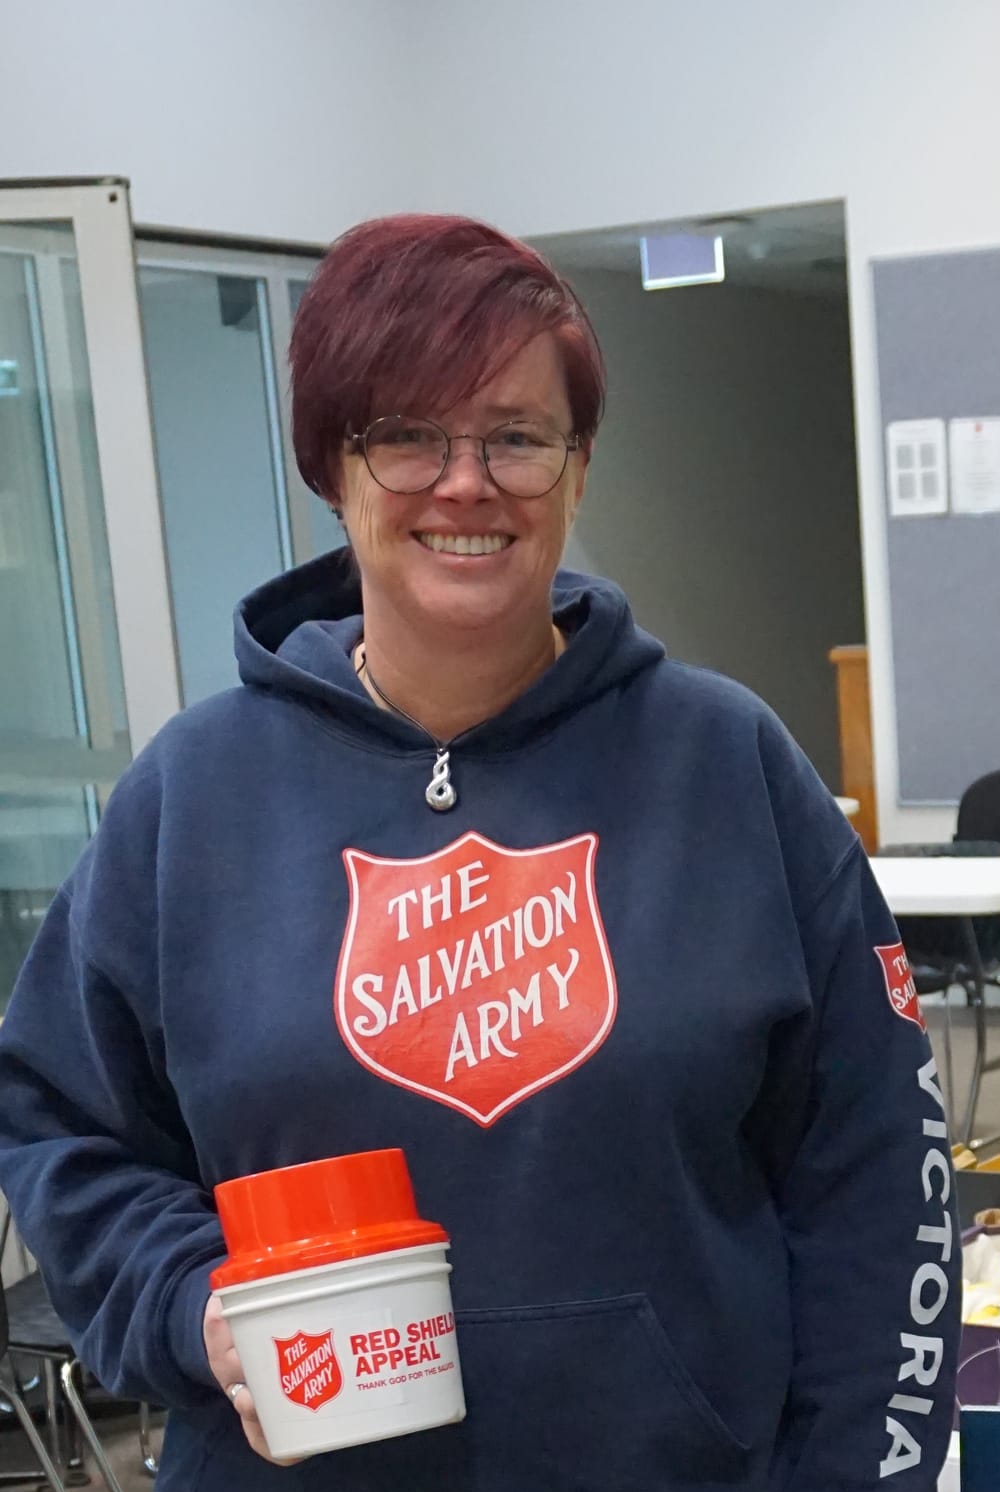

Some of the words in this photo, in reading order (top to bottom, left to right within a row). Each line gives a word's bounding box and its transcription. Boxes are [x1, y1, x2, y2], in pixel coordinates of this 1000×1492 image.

[388, 860, 490, 941] THE
[352, 871, 577, 1037] SALVATION
[445, 948, 579, 1082] ARMY
[879, 1057, 953, 1478] VICTORIA
[284, 1337, 308, 1367] THE
[350, 1328, 400, 1355] RED
[406, 1312, 455, 1343] SHIELD
[282, 1338, 333, 1394] SALVATION
[303, 1362, 333, 1403] ARMY
[355, 1341, 441, 1377] APPEAL
[357, 1379, 387, 1391] THANK
[388, 1375, 407, 1386] GOD
[408, 1371, 423, 1381] FOR
[424, 1367, 438, 1377] THE
